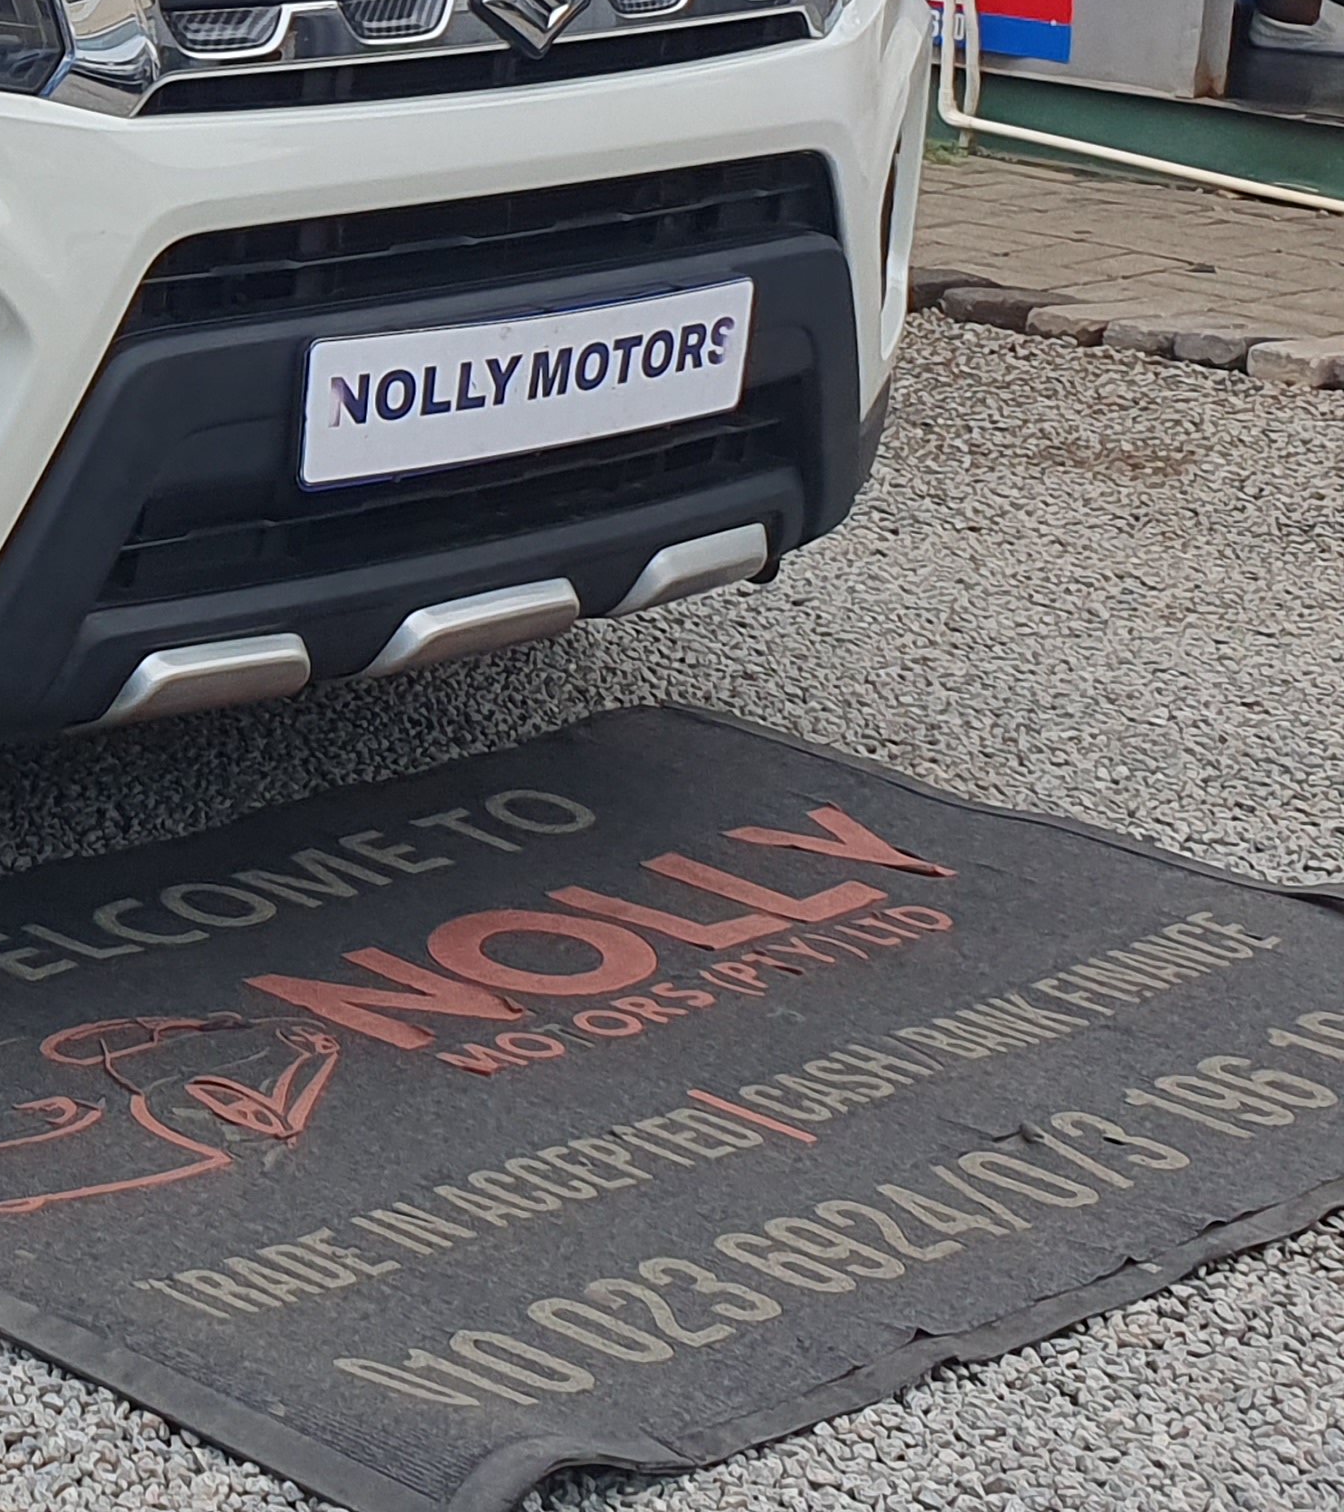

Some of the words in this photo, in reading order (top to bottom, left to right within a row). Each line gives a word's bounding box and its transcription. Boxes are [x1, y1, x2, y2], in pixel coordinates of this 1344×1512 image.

[328, 354, 522, 428] NOLLY
[528, 316, 736, 401] MOTORS
[417, 789, 598, 853] TO
[242, 802, 958, 1050] NOLLY
[436, 982, 716, 1076] MOTORS
[834, 905, 954, 947] LTD
[131, 1226, 402, 1319] TRADE
[350, 1201, 478, 1255] IN
[433, 1107, 764, 1227] ACCEPTED
[1030, 912, 1282, 1016] FINANCE
[333, 1330, 595, 1406] 010
[527, 1257, 783, 1363] 023
[1124, 1055, 1339, 1139] 196
